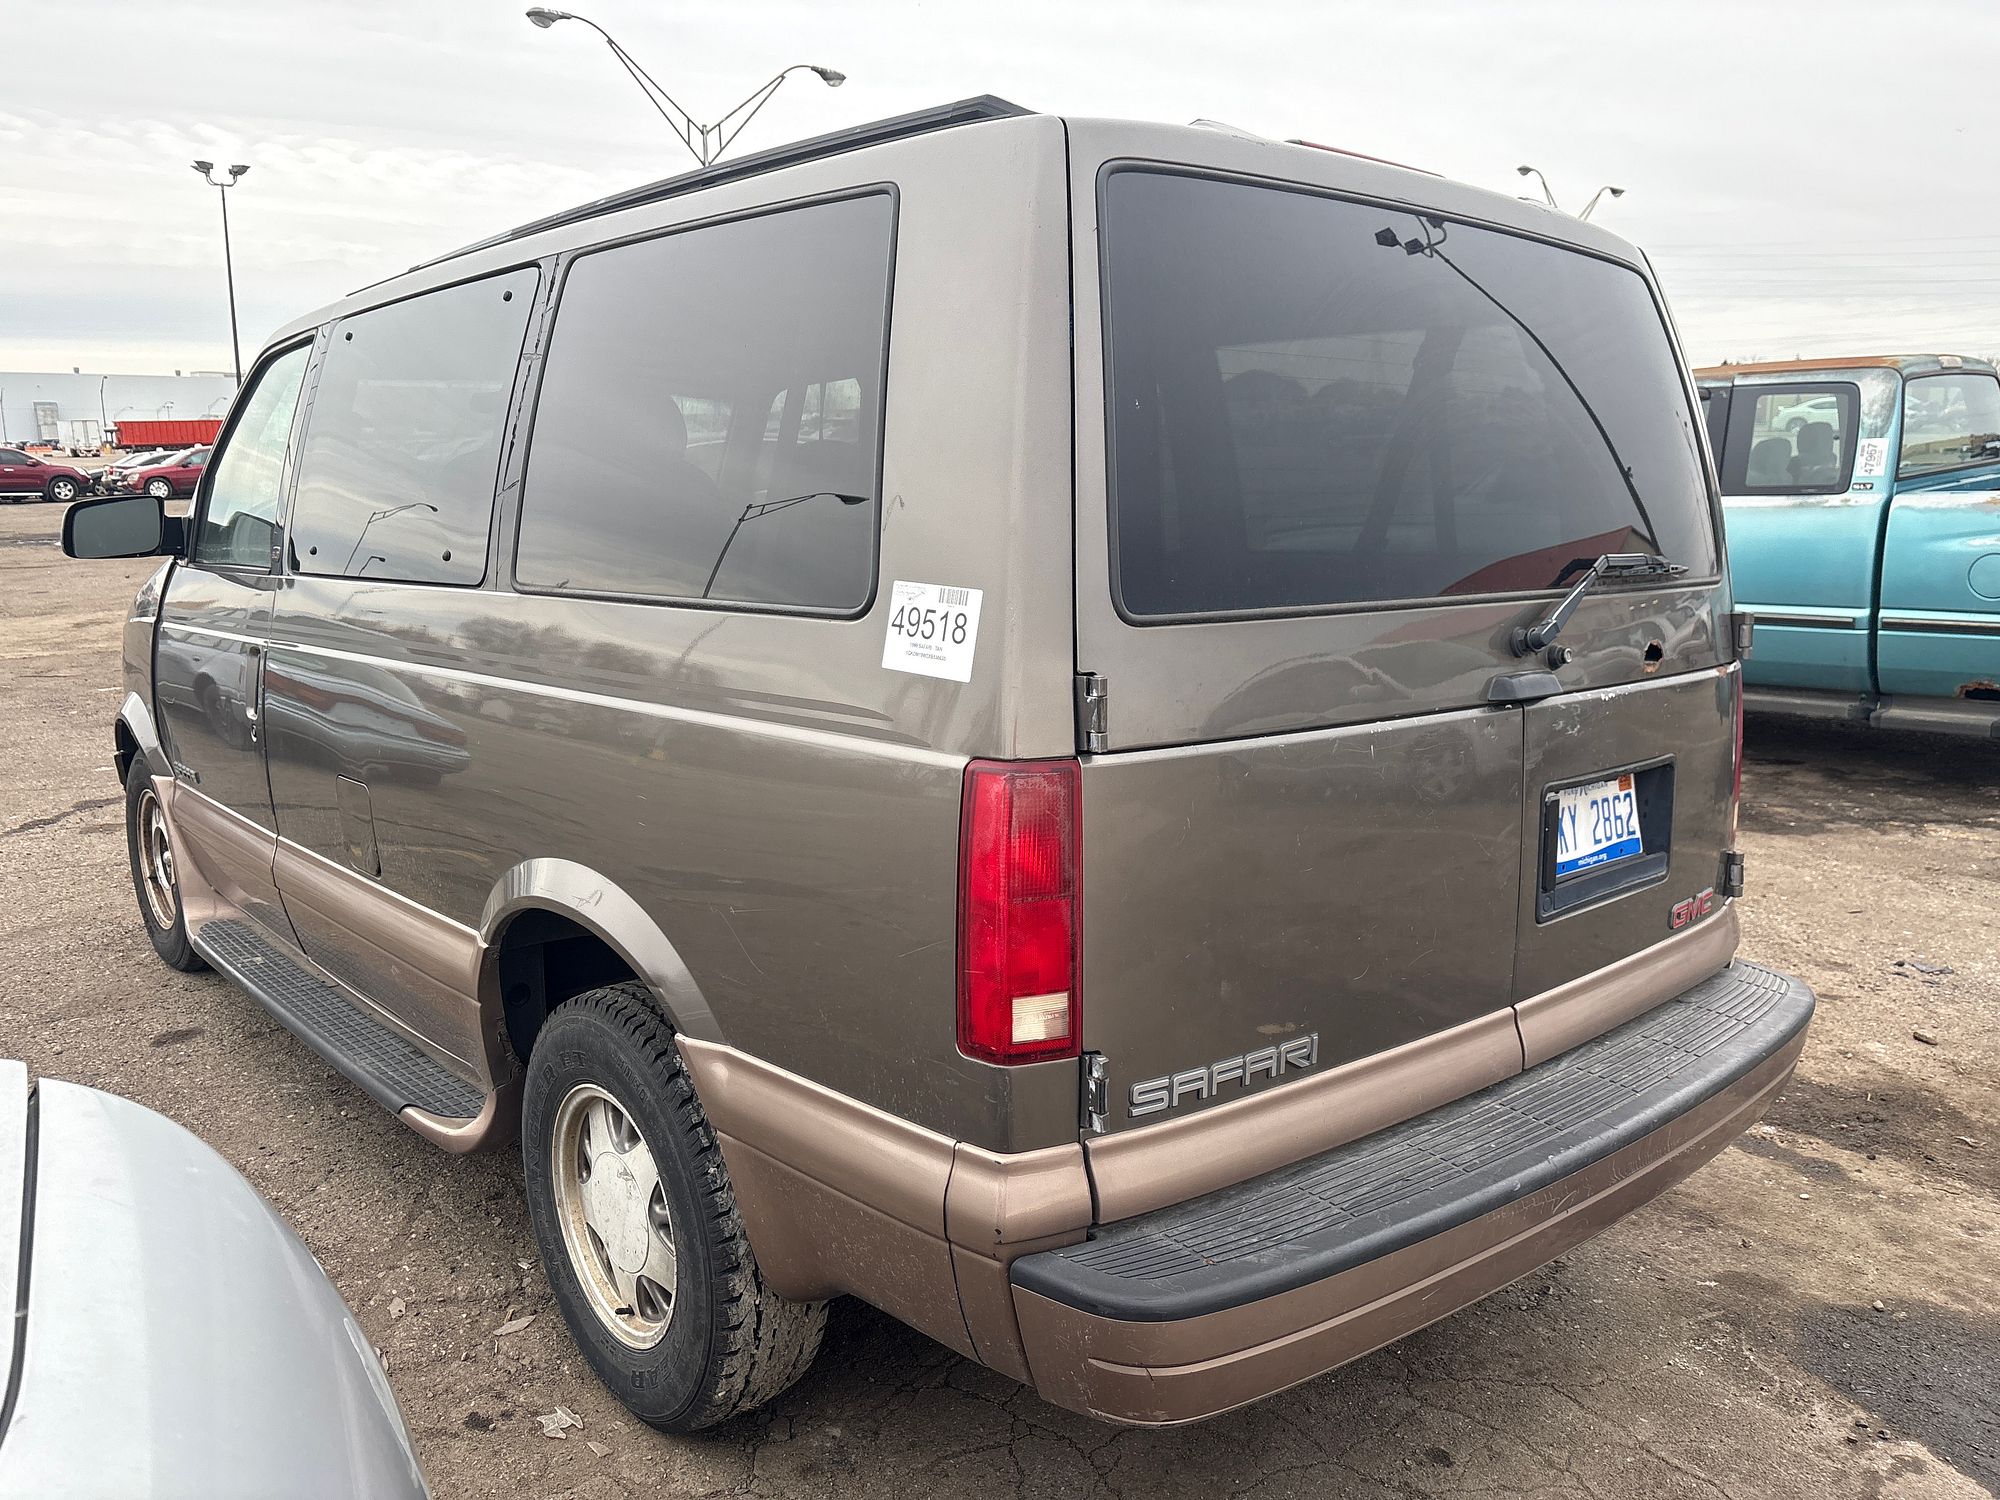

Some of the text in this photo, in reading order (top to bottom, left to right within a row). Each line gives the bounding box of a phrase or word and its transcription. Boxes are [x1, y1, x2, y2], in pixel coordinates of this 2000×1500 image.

[891, 605, 968, 644] 49518
[1590, 791, 1636, 845] 2862
[1578, 852, 1608, 866] michigan.org
[1668, 886, 1714, 930] GMC
[1128, 1032, 1319, 1118] SAFARI
